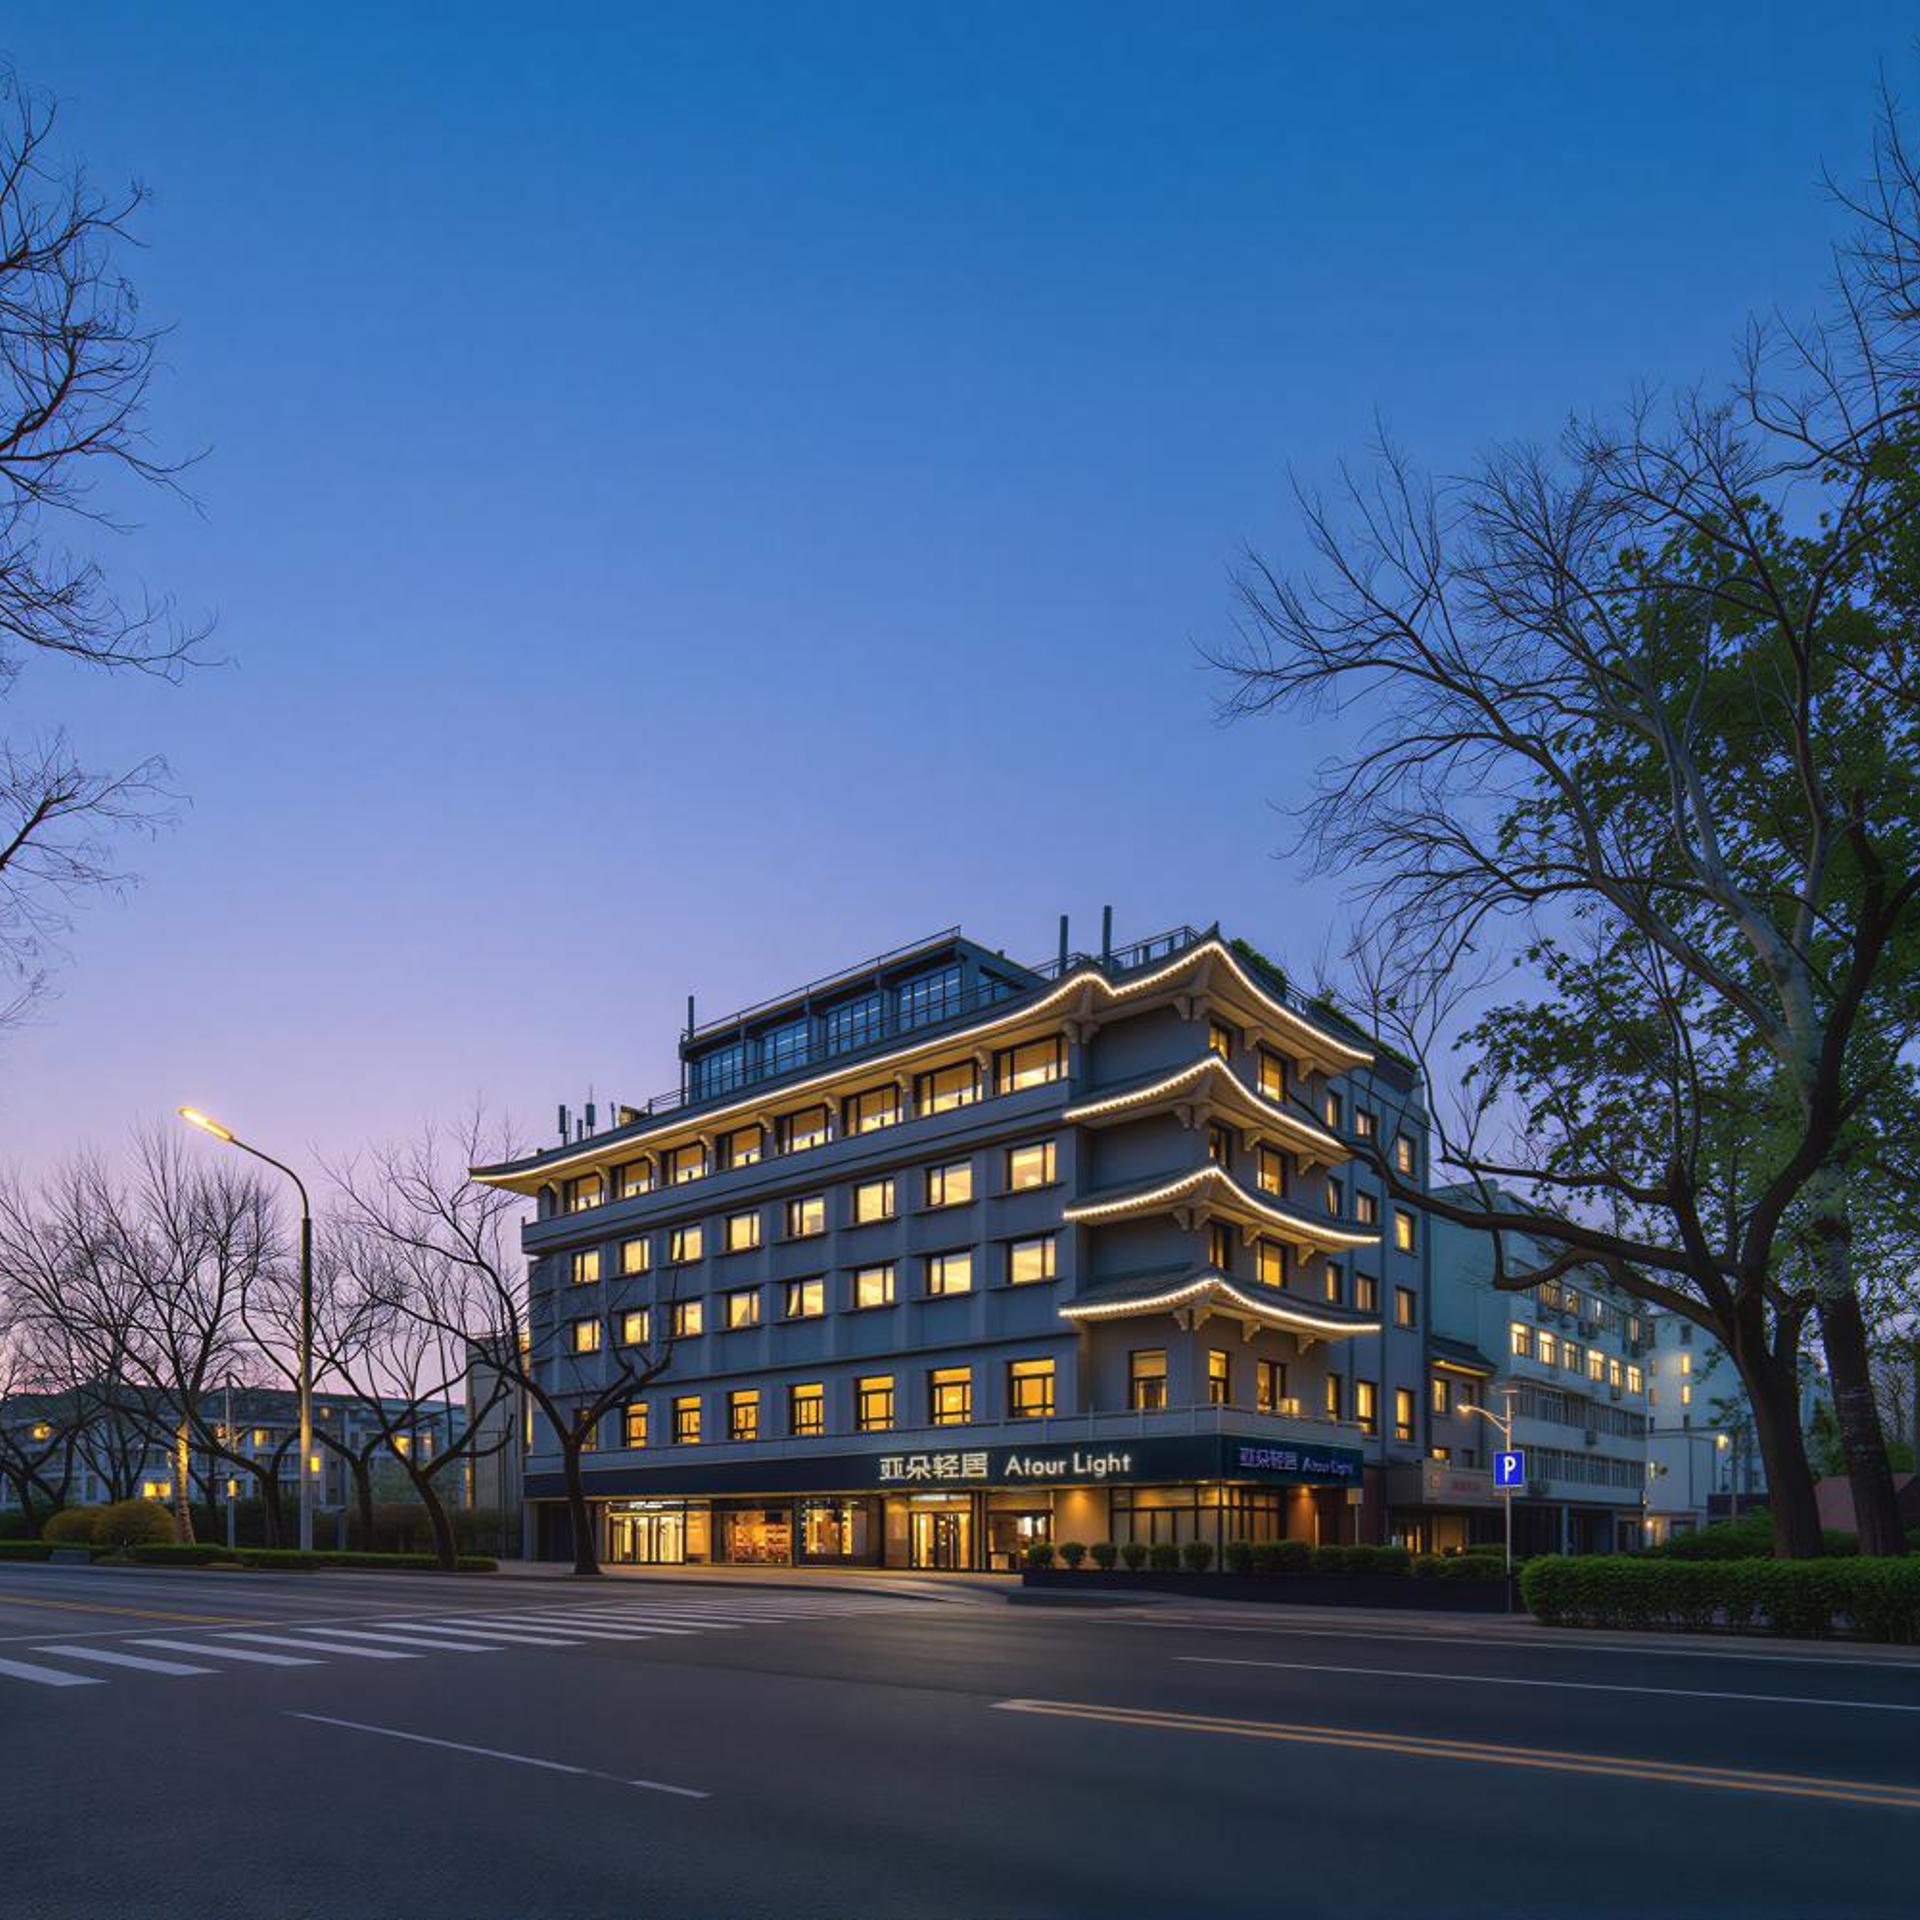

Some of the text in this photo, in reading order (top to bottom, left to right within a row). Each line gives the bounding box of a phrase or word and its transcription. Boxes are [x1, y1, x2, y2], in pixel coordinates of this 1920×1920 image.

[880, 1452, 1132, 1480] 亚朵轻居 Atour Light
[1503, 1456, 1516, 1483] P
